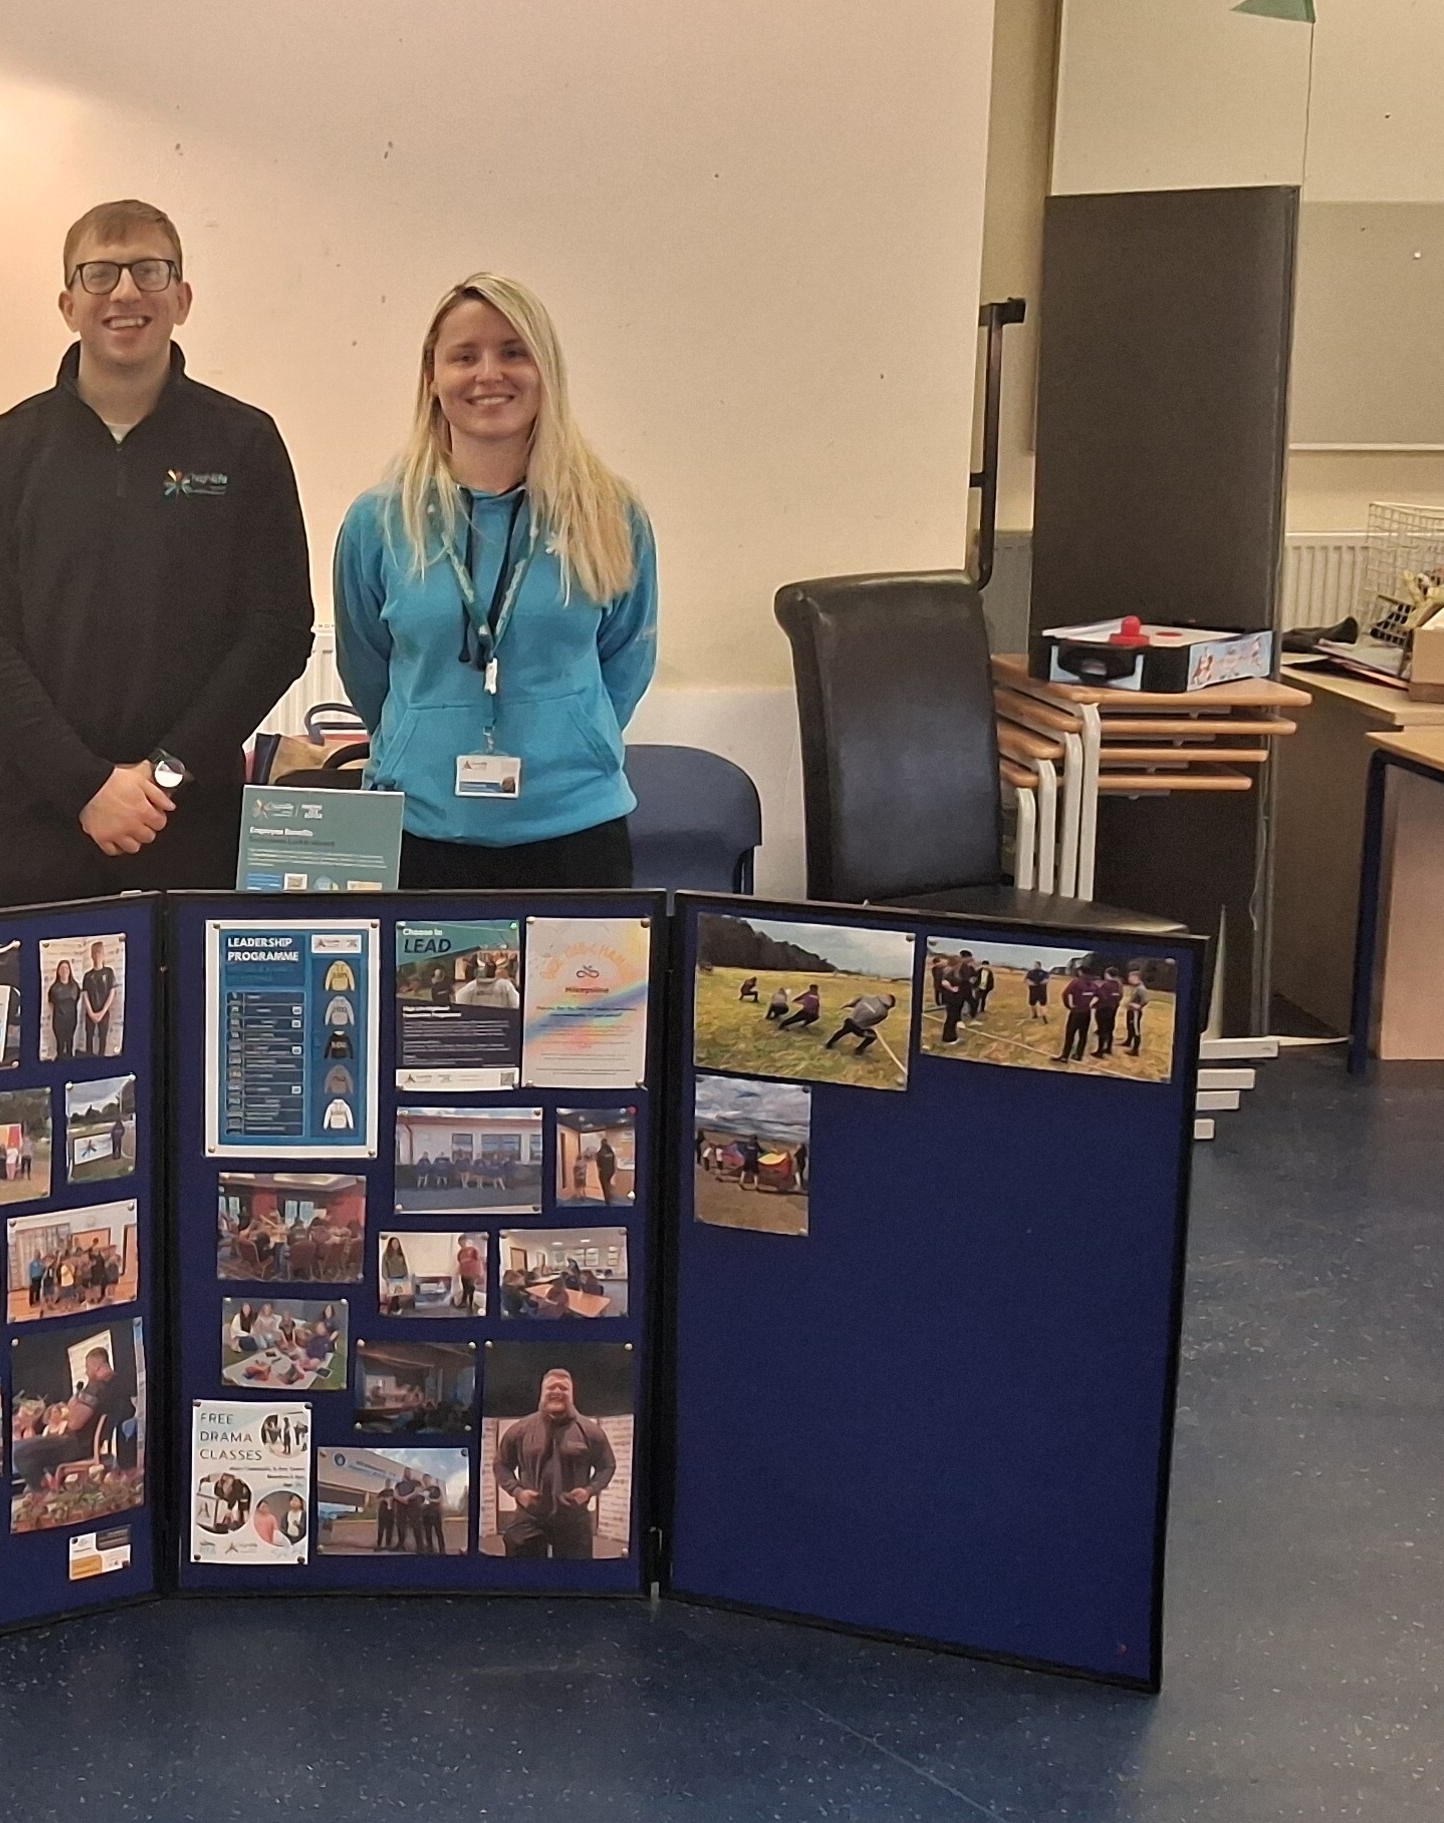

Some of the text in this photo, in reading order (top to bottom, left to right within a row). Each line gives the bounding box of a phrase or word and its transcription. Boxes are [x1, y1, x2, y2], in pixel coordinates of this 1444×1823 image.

[403, 928, 443, 936] Choose to
[227, 937, 293, 948] LEADERSHIP
[404, 938, 452, 954] LEAD
[227, 951, 299, 961] PROGRAMME
[200, 1412, 234, 1425] FREE
[199, 1431, 253, 1442] DRAMA
[199, 1449, 262, 1461] CLASSES
